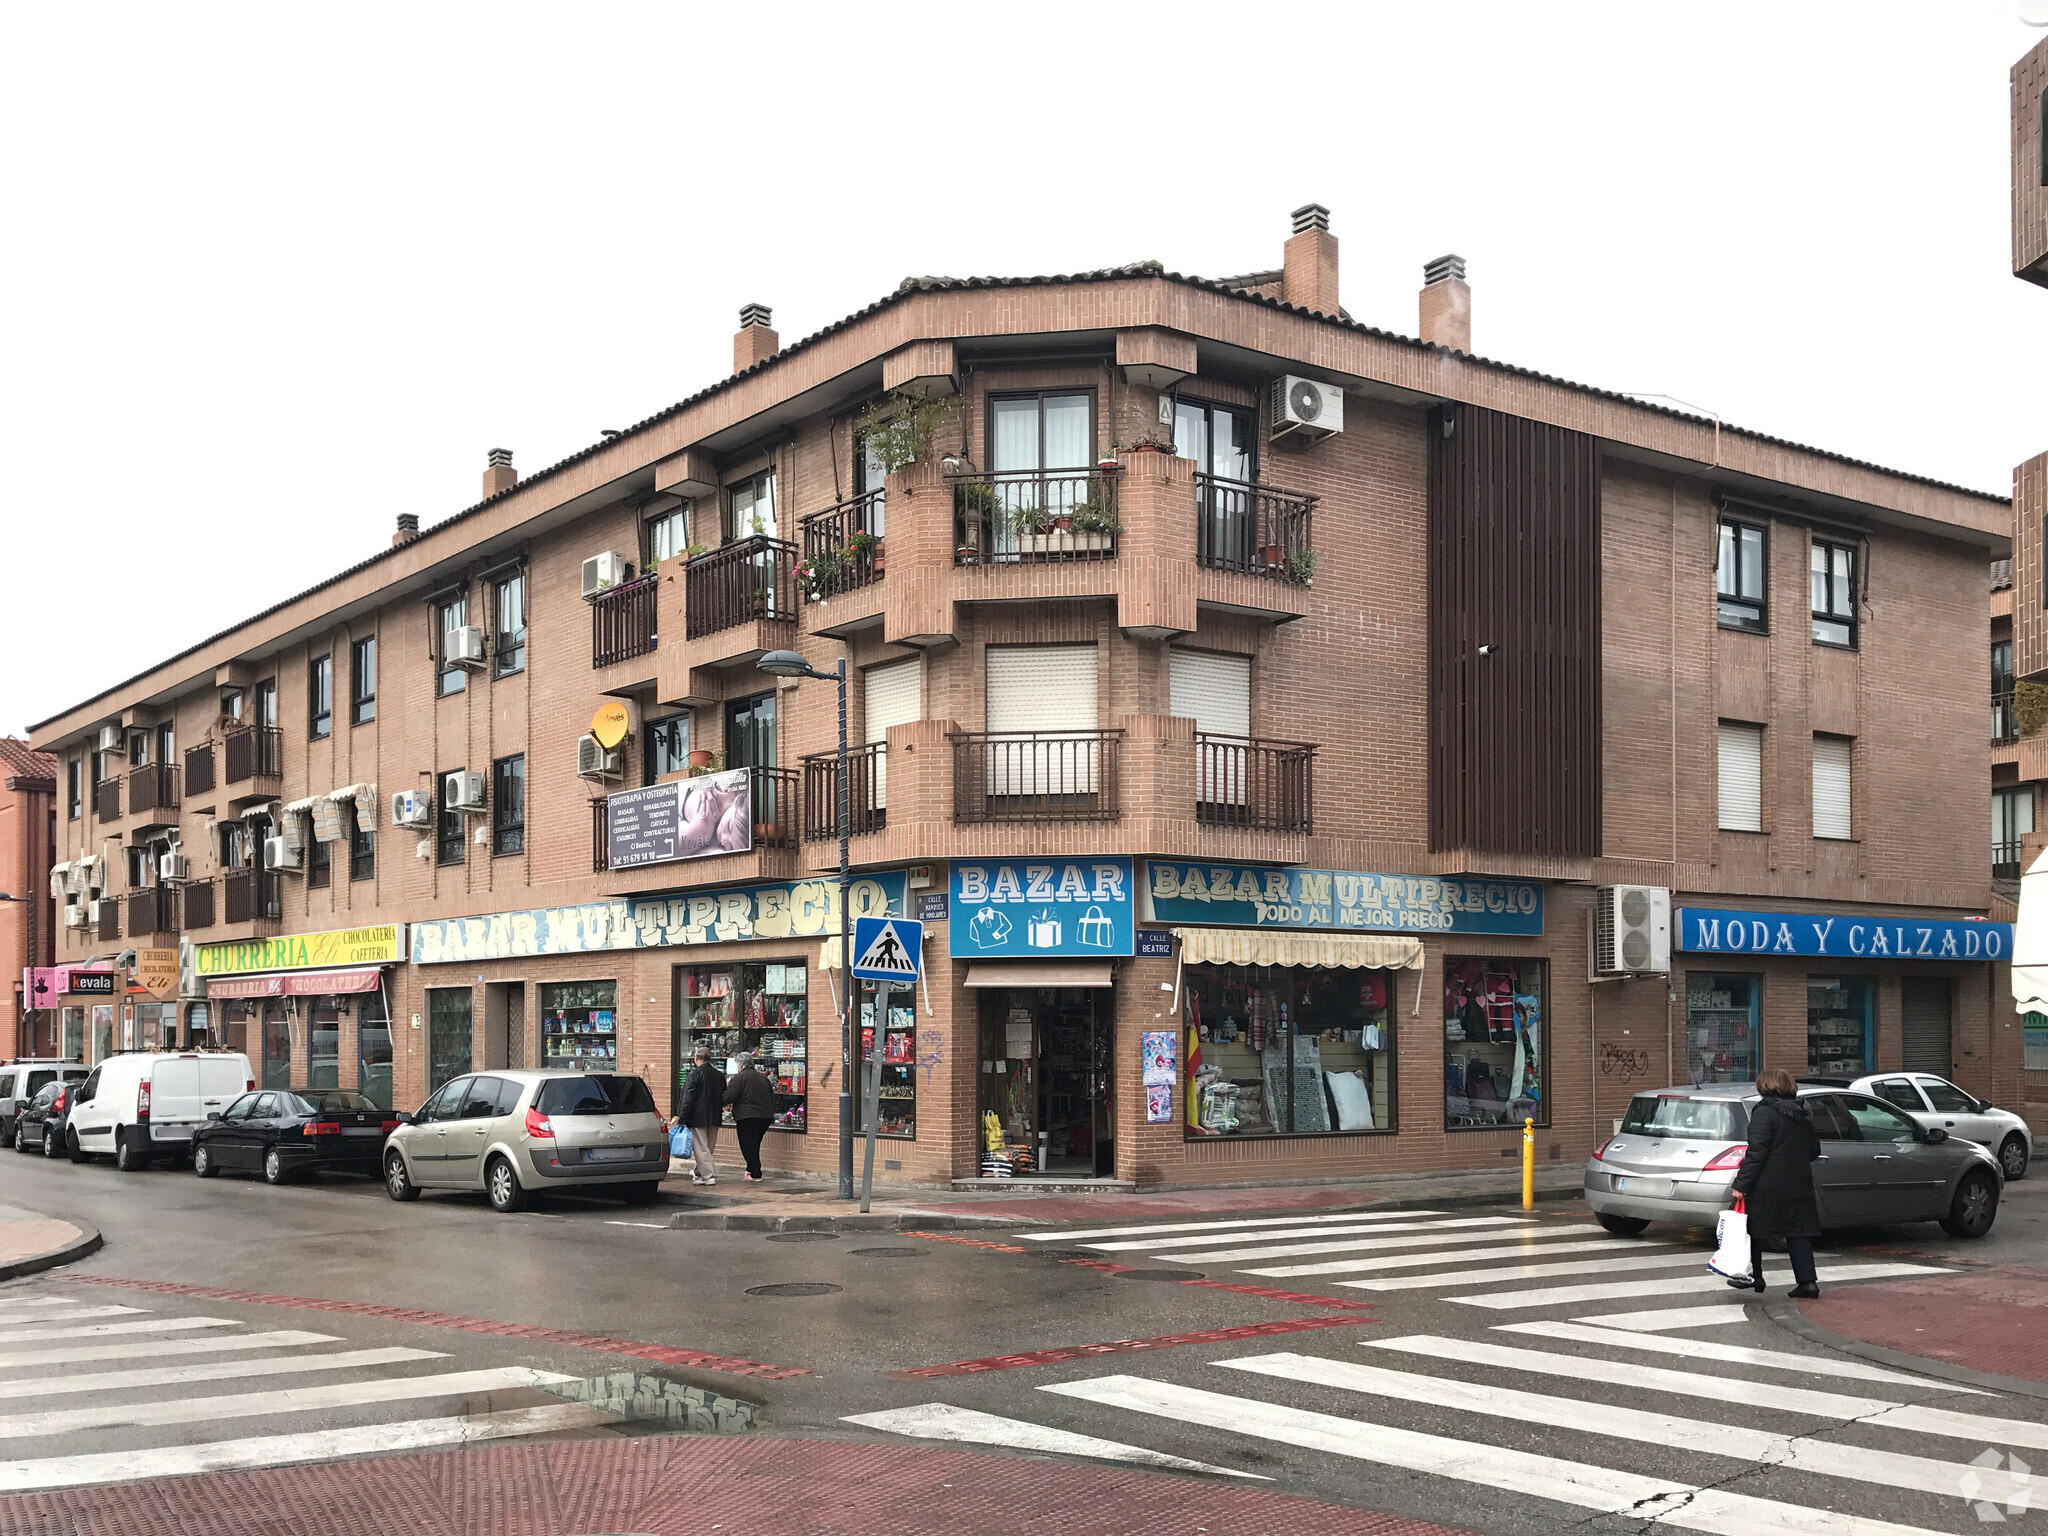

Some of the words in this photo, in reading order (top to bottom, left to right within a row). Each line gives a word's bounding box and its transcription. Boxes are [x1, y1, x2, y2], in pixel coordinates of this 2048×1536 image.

[610, 793, 642, 806] FISIOTERAPIA
[642, 792, 646, 800] Y
[646, 784, 678, 800] OSTEOPATÍA
[618, 807, 635, 816] MASAJES
[643, 827, 676, 838] CONTRACTURAS
[623, 855, 629, 864] 91
[630, 854, 640, 862] 679
[641, 852, 648, 860] 14
[649, 851, 656, 860] 10
[958, 864, 1126, 904] BAZAR
[1152, 865, 1292, 905] BAZAR
[1299, 872, 1538, 915] MULTIPRECIO
[420, 913, 542, 962] BAZAR
[544, 879, 889, 952] MULTIPRECIO
[1254, 900, 1302, 925] TODO
[1307, 905, 1332, 925] AL
[1340, 908, 1395, 927] MEJOR
[1399, 908, 1455, 930] PRECIO
[343, 925, 397, 945] CHOCOLATERIA
[1696, 917, 1797, 953] MODA
[1812, 917, 1834, 953] Y
[1849, 925, 2002, 958] CALZADO
[143, 951, 174, 961] CHURRERIA
[198, 937, 310, 973] CHURRERIA
[312, 934, 342, 965] Eli
[350, 946, 389, 962] CAFETERIA
[1142, 944, 1170, 953] BEATRIZ
[72, 973, 111, 988] kevala
[147, 976, 170, 988] Eli
[209, 981, 265, 996] CHURRERIA
